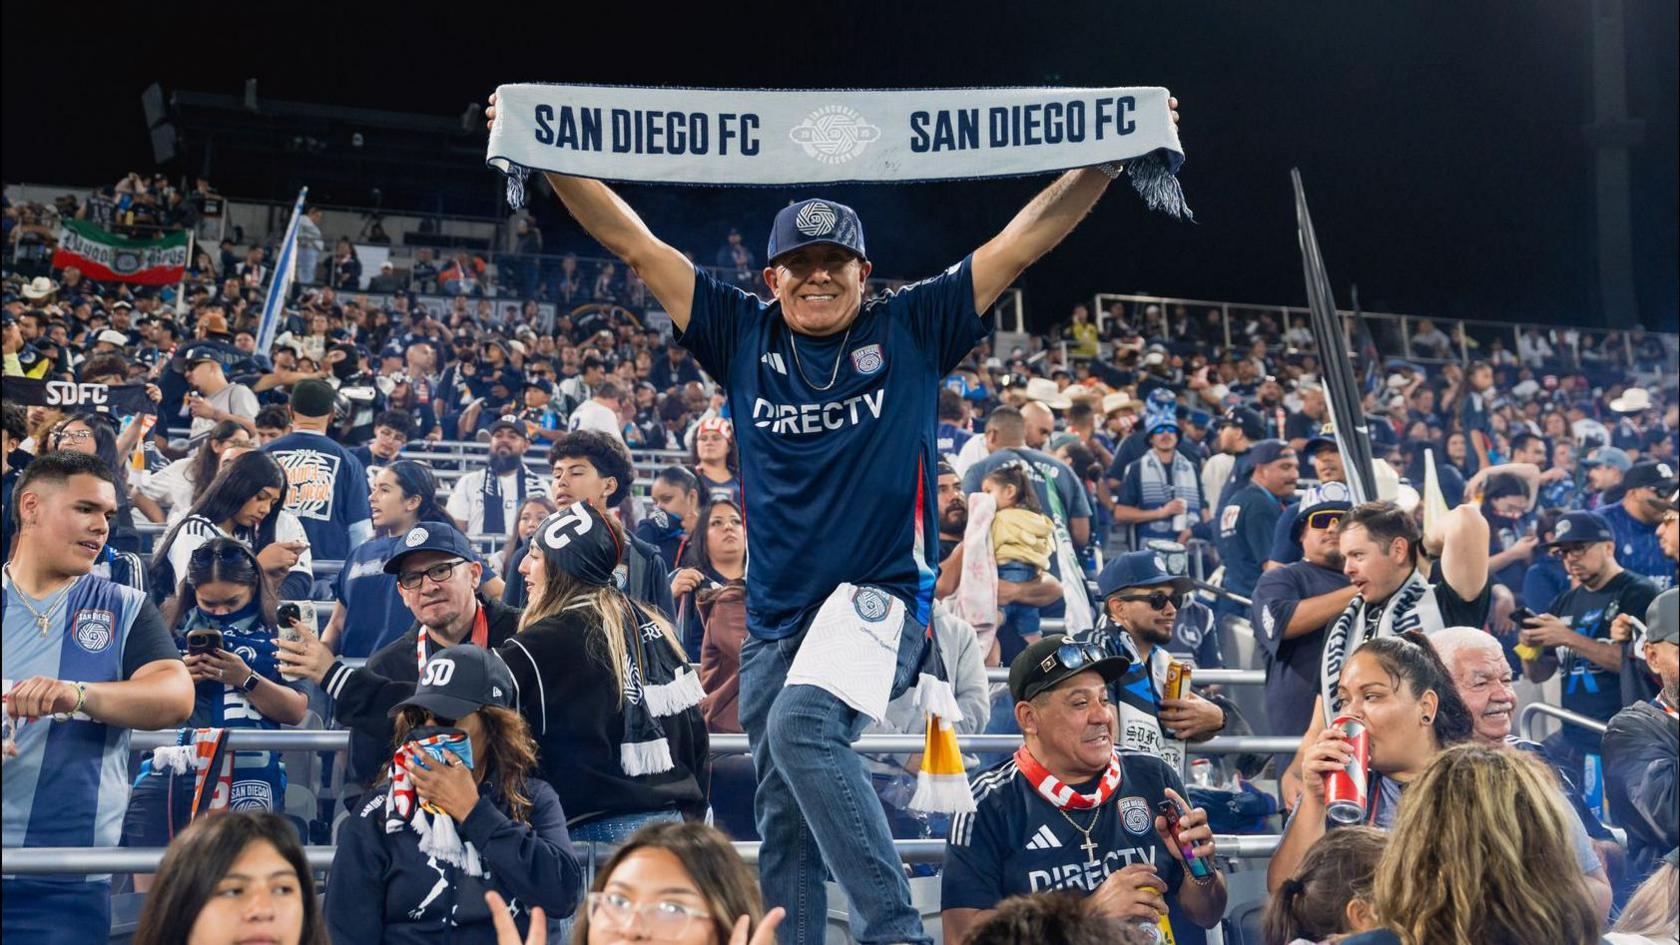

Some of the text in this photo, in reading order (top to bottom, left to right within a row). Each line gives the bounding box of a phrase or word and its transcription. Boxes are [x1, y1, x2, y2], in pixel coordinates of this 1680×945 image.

[534, 103, 760, 157] SAN DIEGO FC
[910, 96, 1136, 153] SAN DIEGO FC
[45, 380, 108, 406] SDFC
[752, 388, 885, 434] DIRECTV
[78, 612, 111, 623] SAN DIEGO
[421, 658, 456, 687] SD
[231, 786, 269, 799] SAN DIEGO
[1028, 845, 1156, 894] DIRECTV
